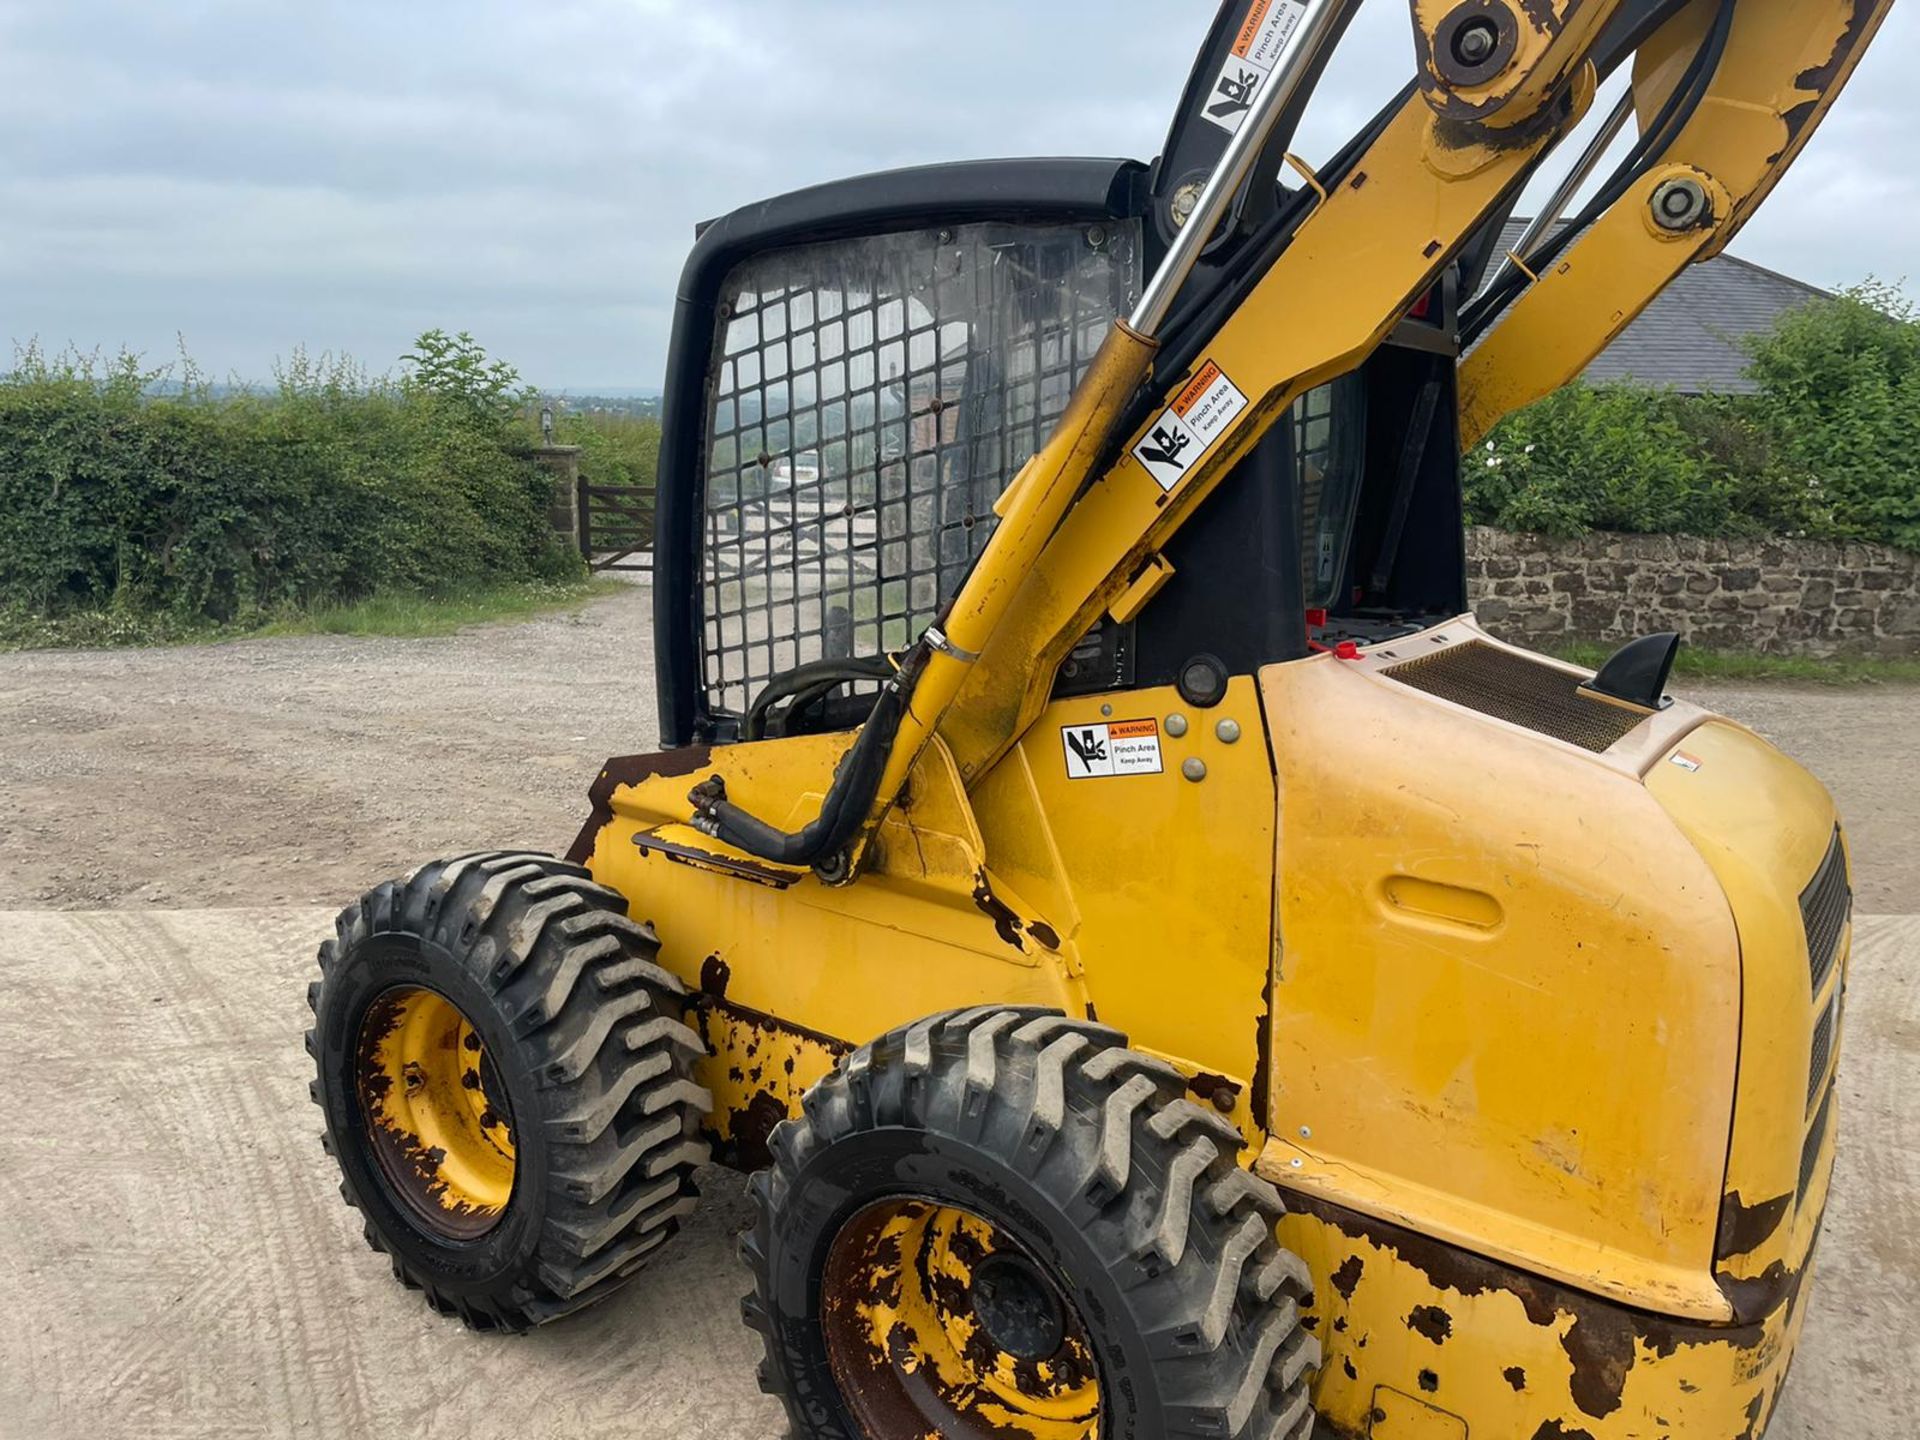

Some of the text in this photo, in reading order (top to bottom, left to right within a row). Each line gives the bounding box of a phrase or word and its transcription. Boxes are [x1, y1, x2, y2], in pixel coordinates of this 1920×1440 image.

[1242, 0, 1266, 42] WARNIN
[1255, 2, 1288, 60] Pinch Area
[1269, 13, 1297, 60] Keep Away
[1183, 367, 1217, 404] WARNING
[1190, 384, 1230, 427] Pinch Area
[1202, 398, 1234, 432] Keep Away
[1114, 744, 1156, 754] Pinch Area
[1119, 724, 1155, 735] WARNING
